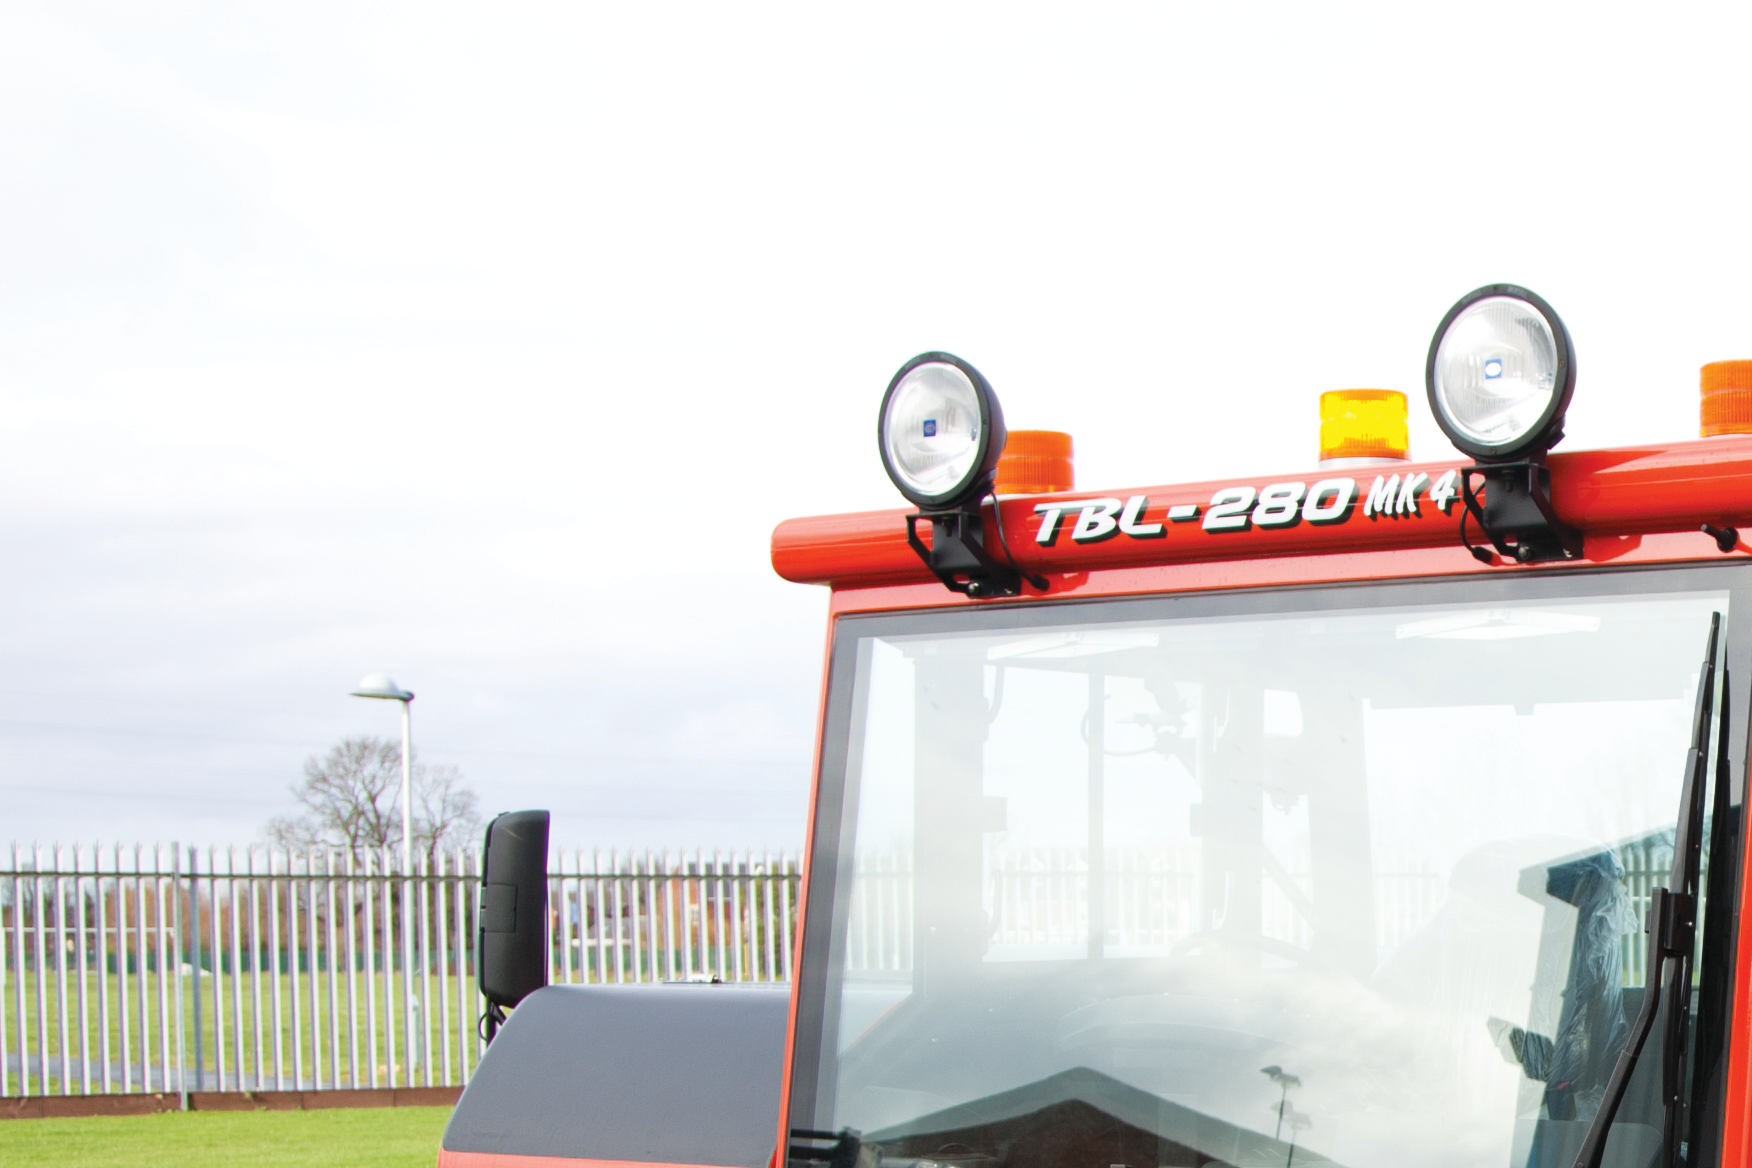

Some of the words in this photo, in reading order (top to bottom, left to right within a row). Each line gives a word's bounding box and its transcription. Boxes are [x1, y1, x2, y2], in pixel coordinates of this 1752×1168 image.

[1033, 477, 1358, 545] TBL-280
[1363, 472, 1430, 519] MK
[1429, 469, 1459, 514] 4
